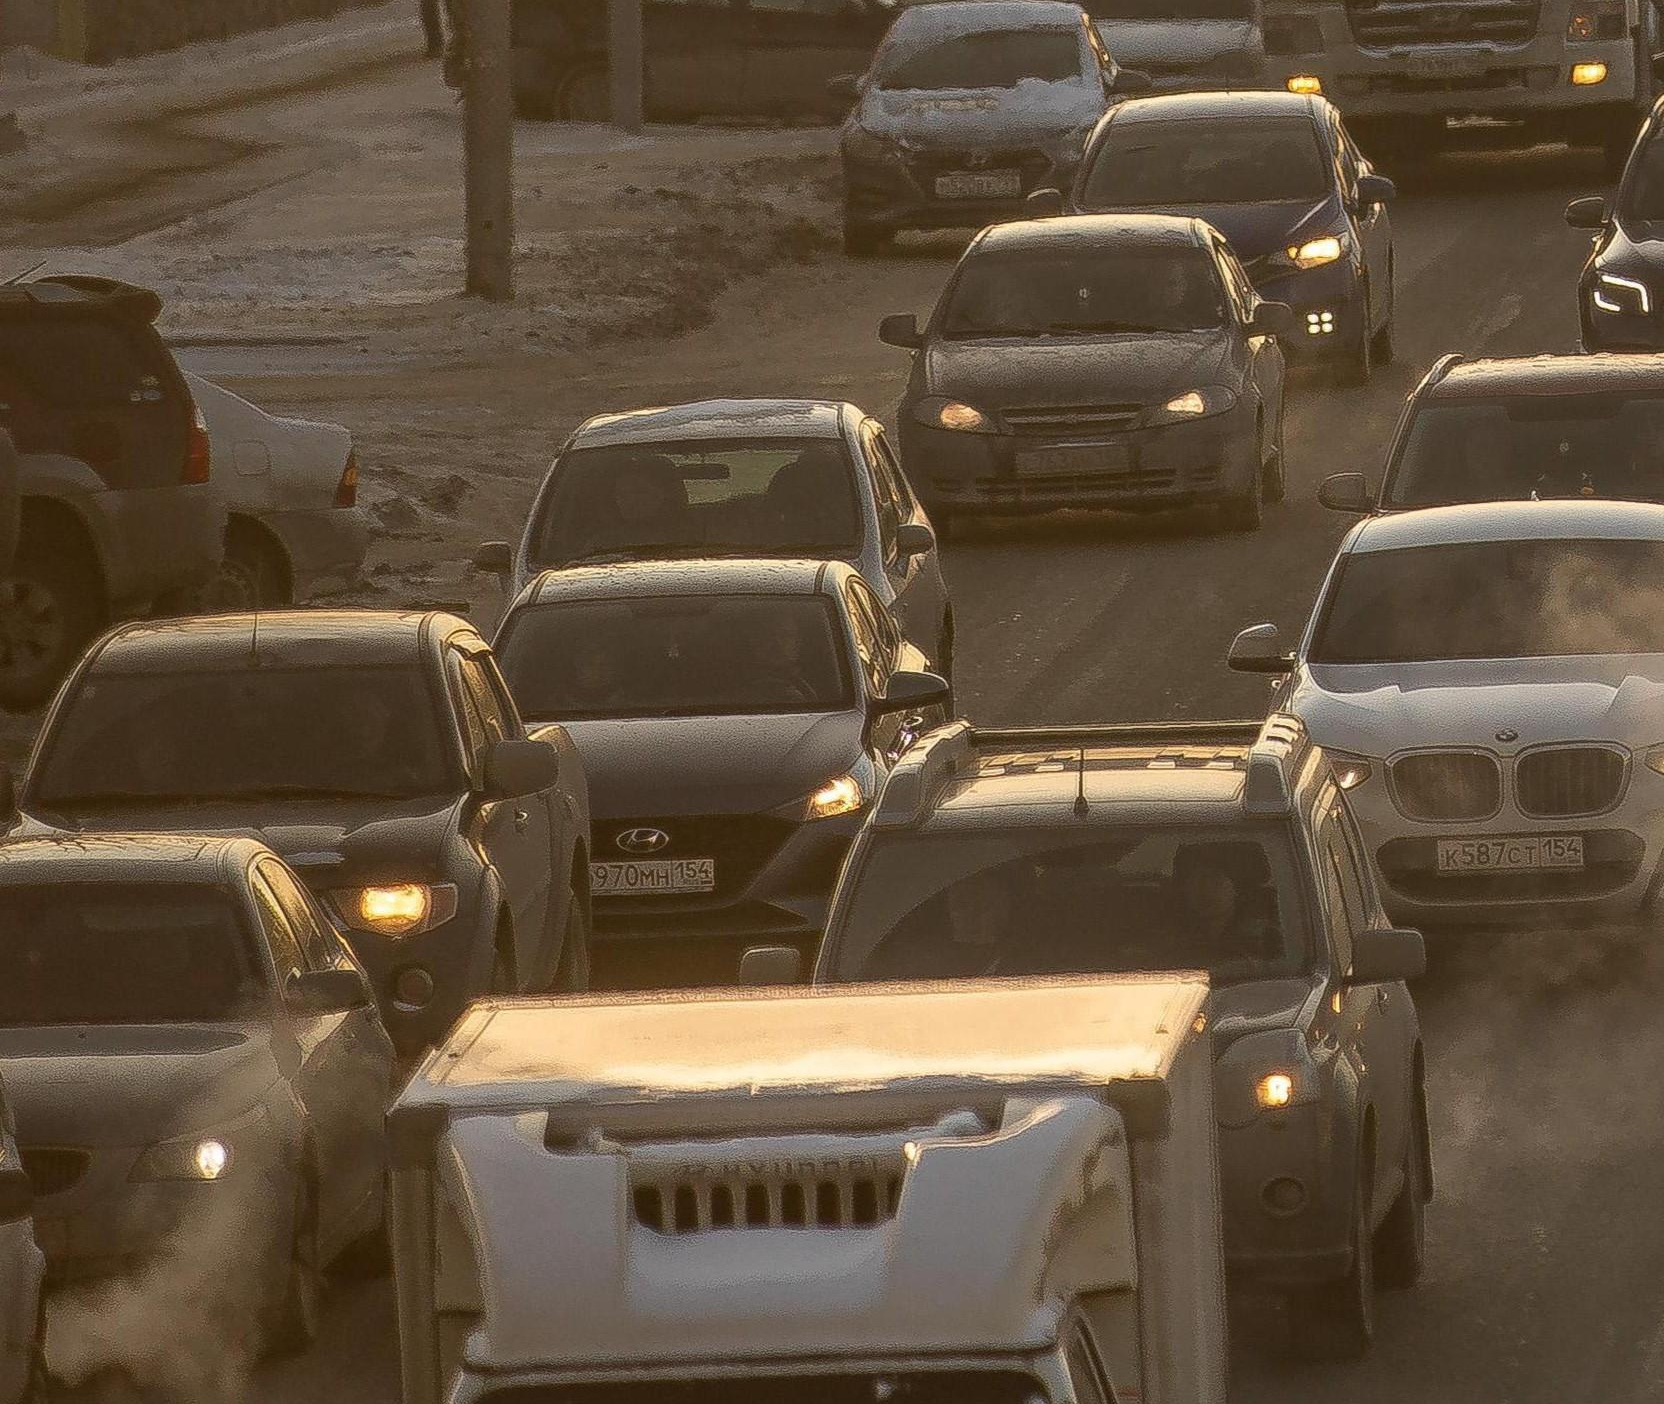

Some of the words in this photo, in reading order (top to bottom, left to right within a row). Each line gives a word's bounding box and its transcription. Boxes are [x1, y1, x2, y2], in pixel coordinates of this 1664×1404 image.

[1446, 842, 1537, 867] К587СТ
[1543, 838, 1581, 858] 154
[589, 863, 671, 888] 970МН
[674, 860, 713, 880] 154
